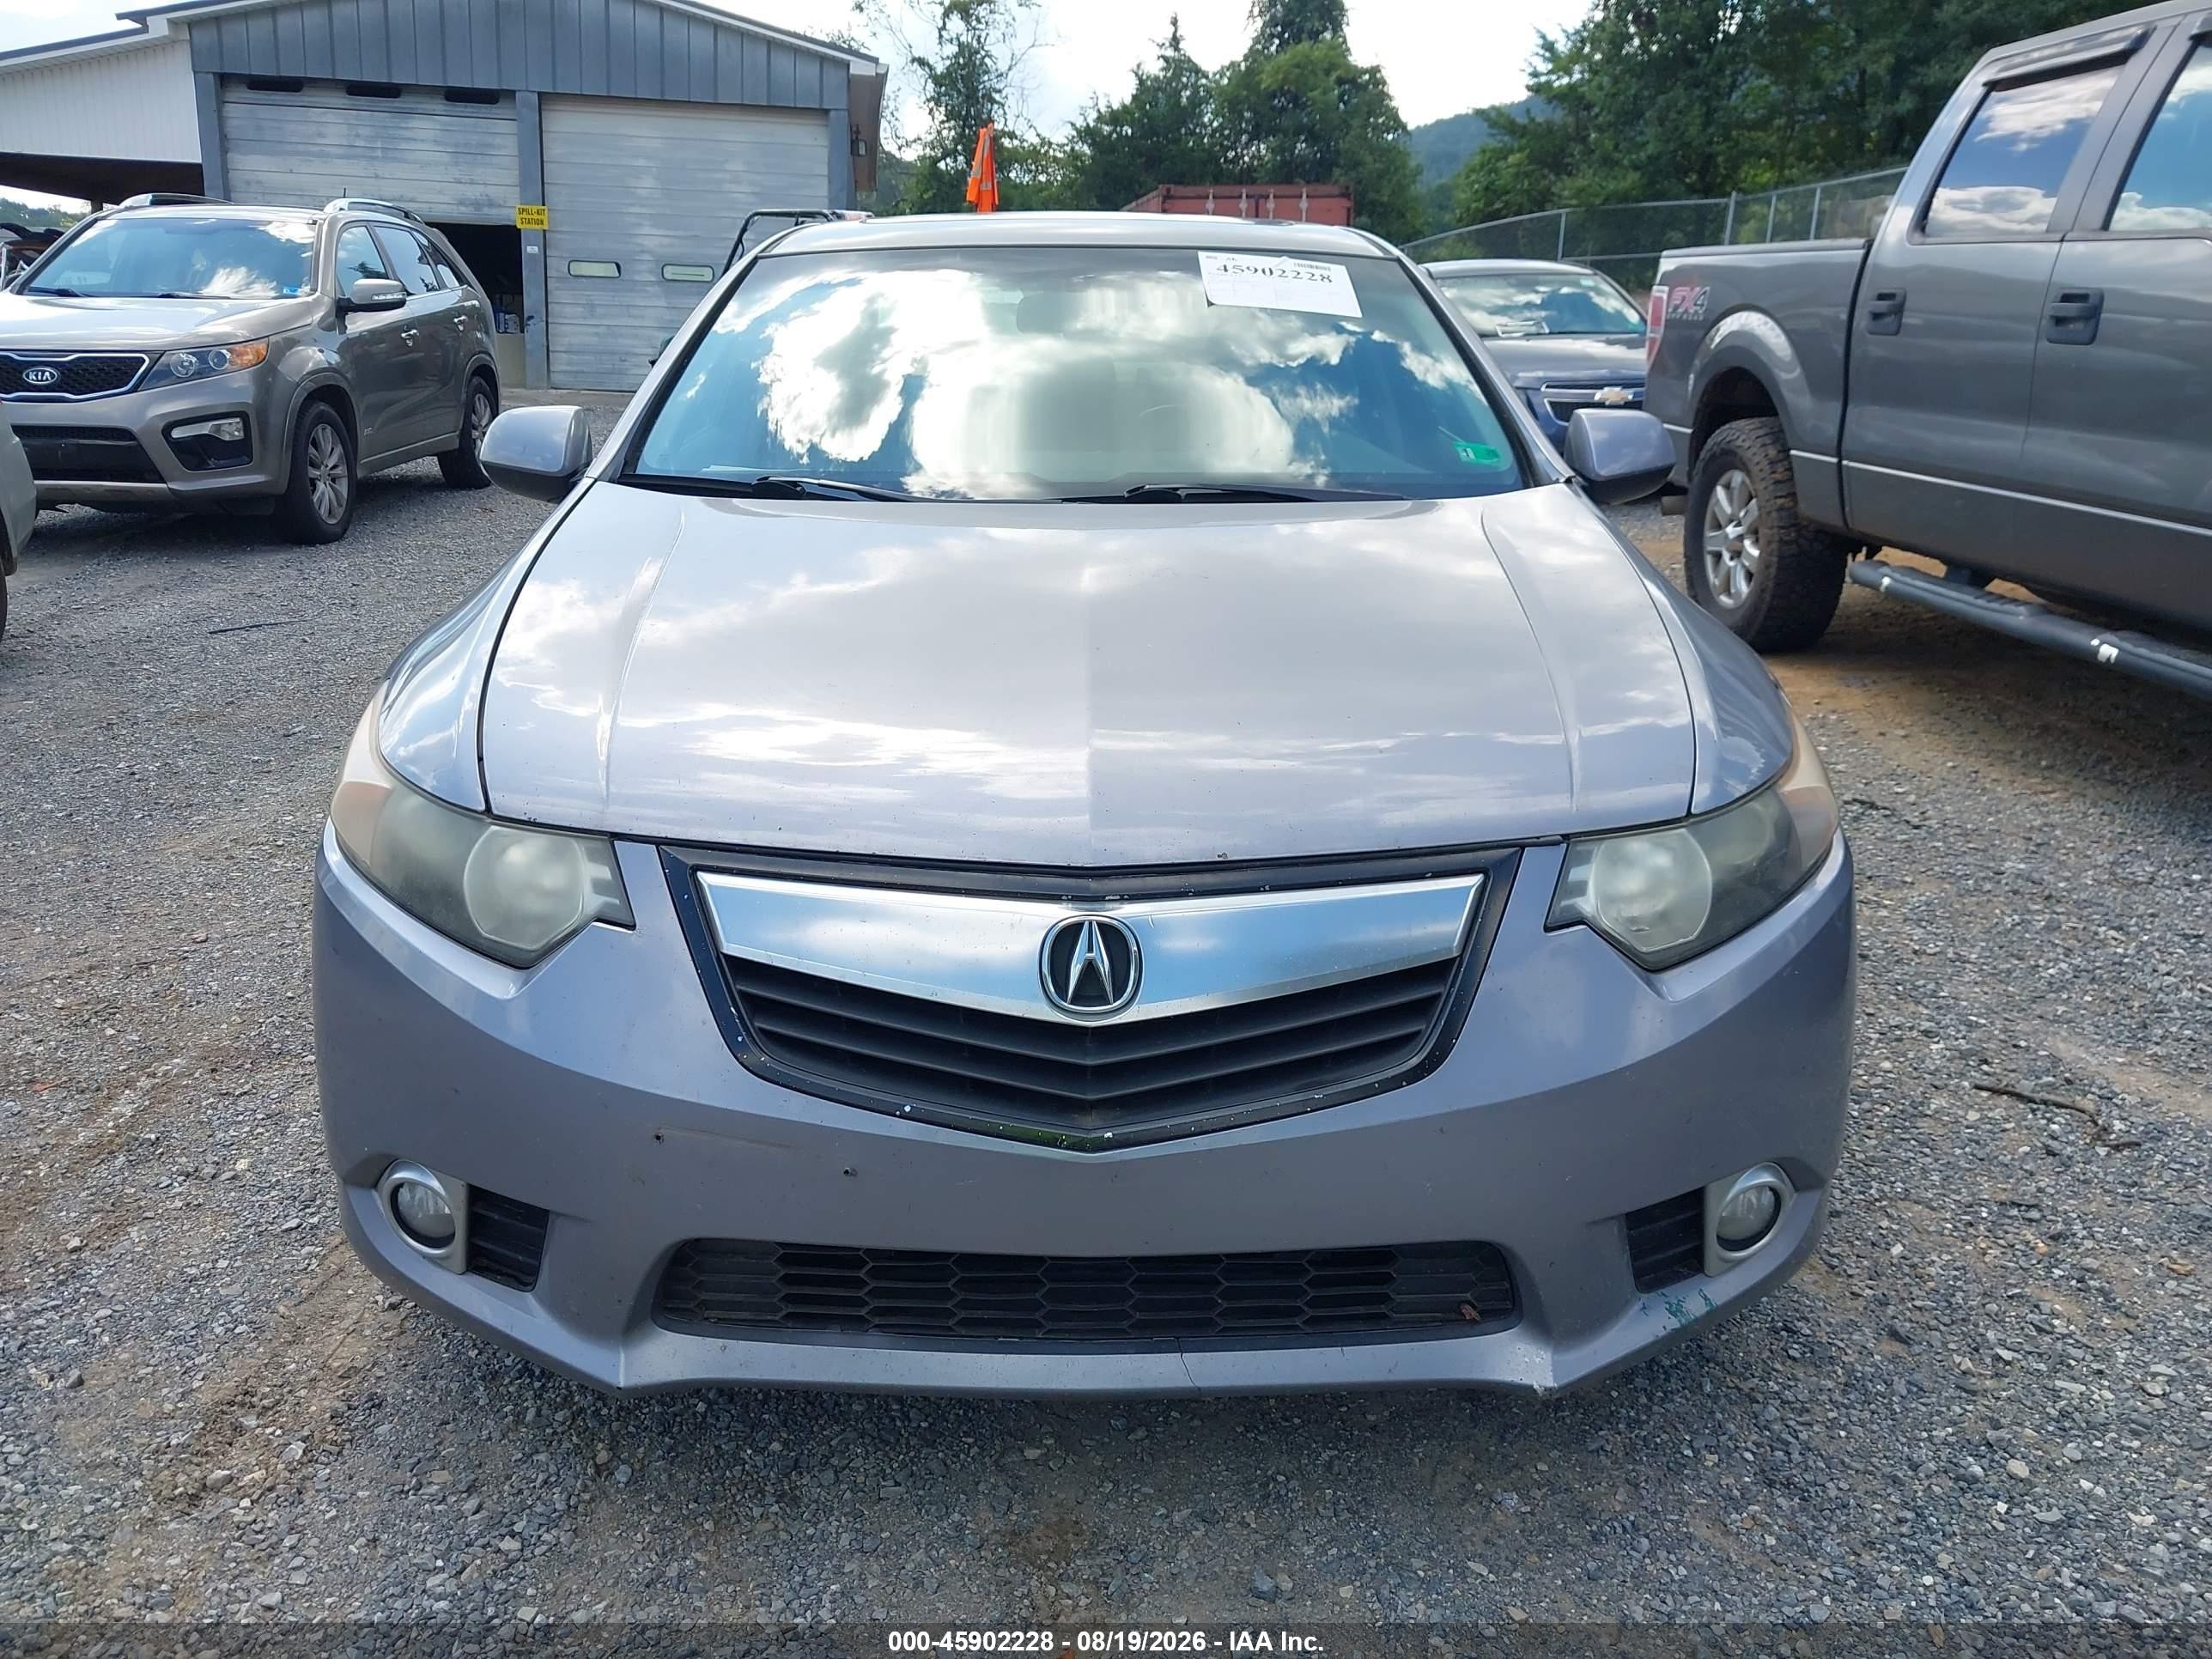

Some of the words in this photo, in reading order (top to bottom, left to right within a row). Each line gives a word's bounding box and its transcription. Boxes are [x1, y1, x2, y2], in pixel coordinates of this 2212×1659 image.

[520, 217, 544, 226] STATION
[1216, 263, 1334, 283] 45902228
[1668, 286, 1711, 313] FX4
[28, 371, 52, 380] KIA
